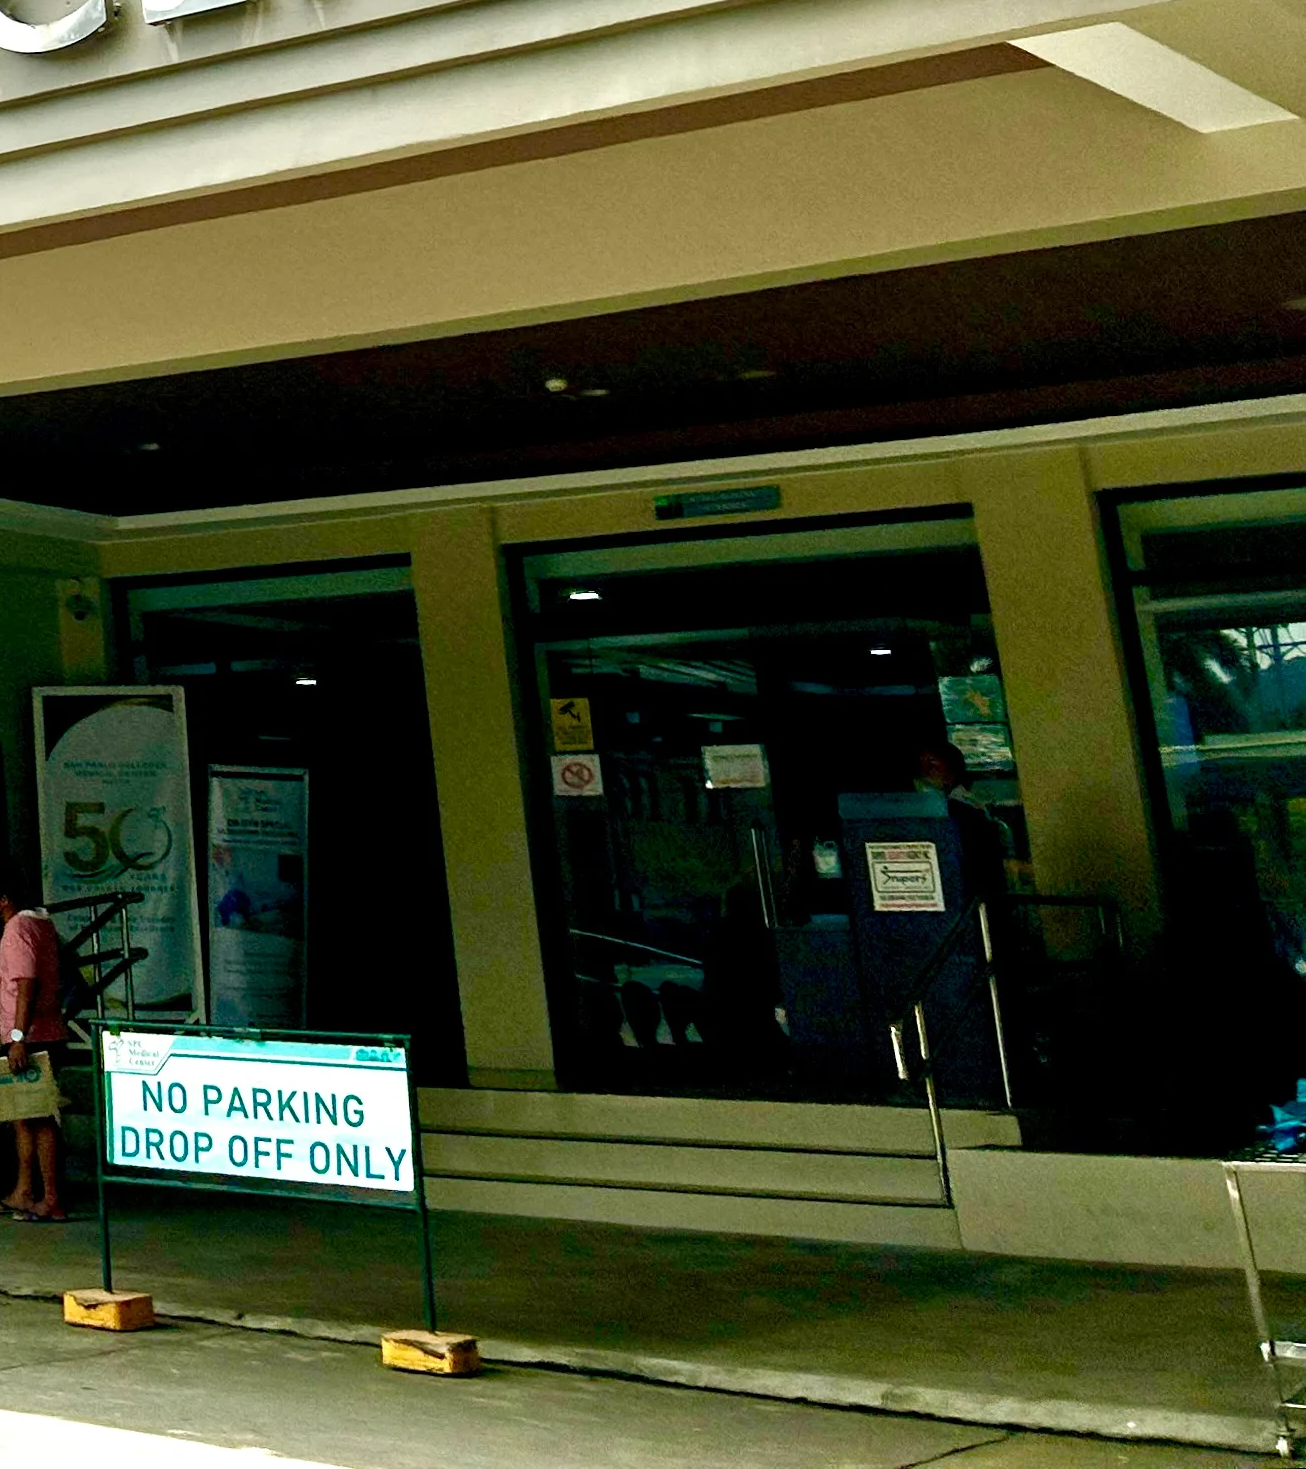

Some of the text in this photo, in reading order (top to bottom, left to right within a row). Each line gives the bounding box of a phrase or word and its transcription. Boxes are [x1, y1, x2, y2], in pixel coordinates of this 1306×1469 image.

[63, 801, 173, 873] 50
[142, 1080, 365, 1128] NO PARKING
[120, 1126, 407, 1182] DROP OFF ONLY
